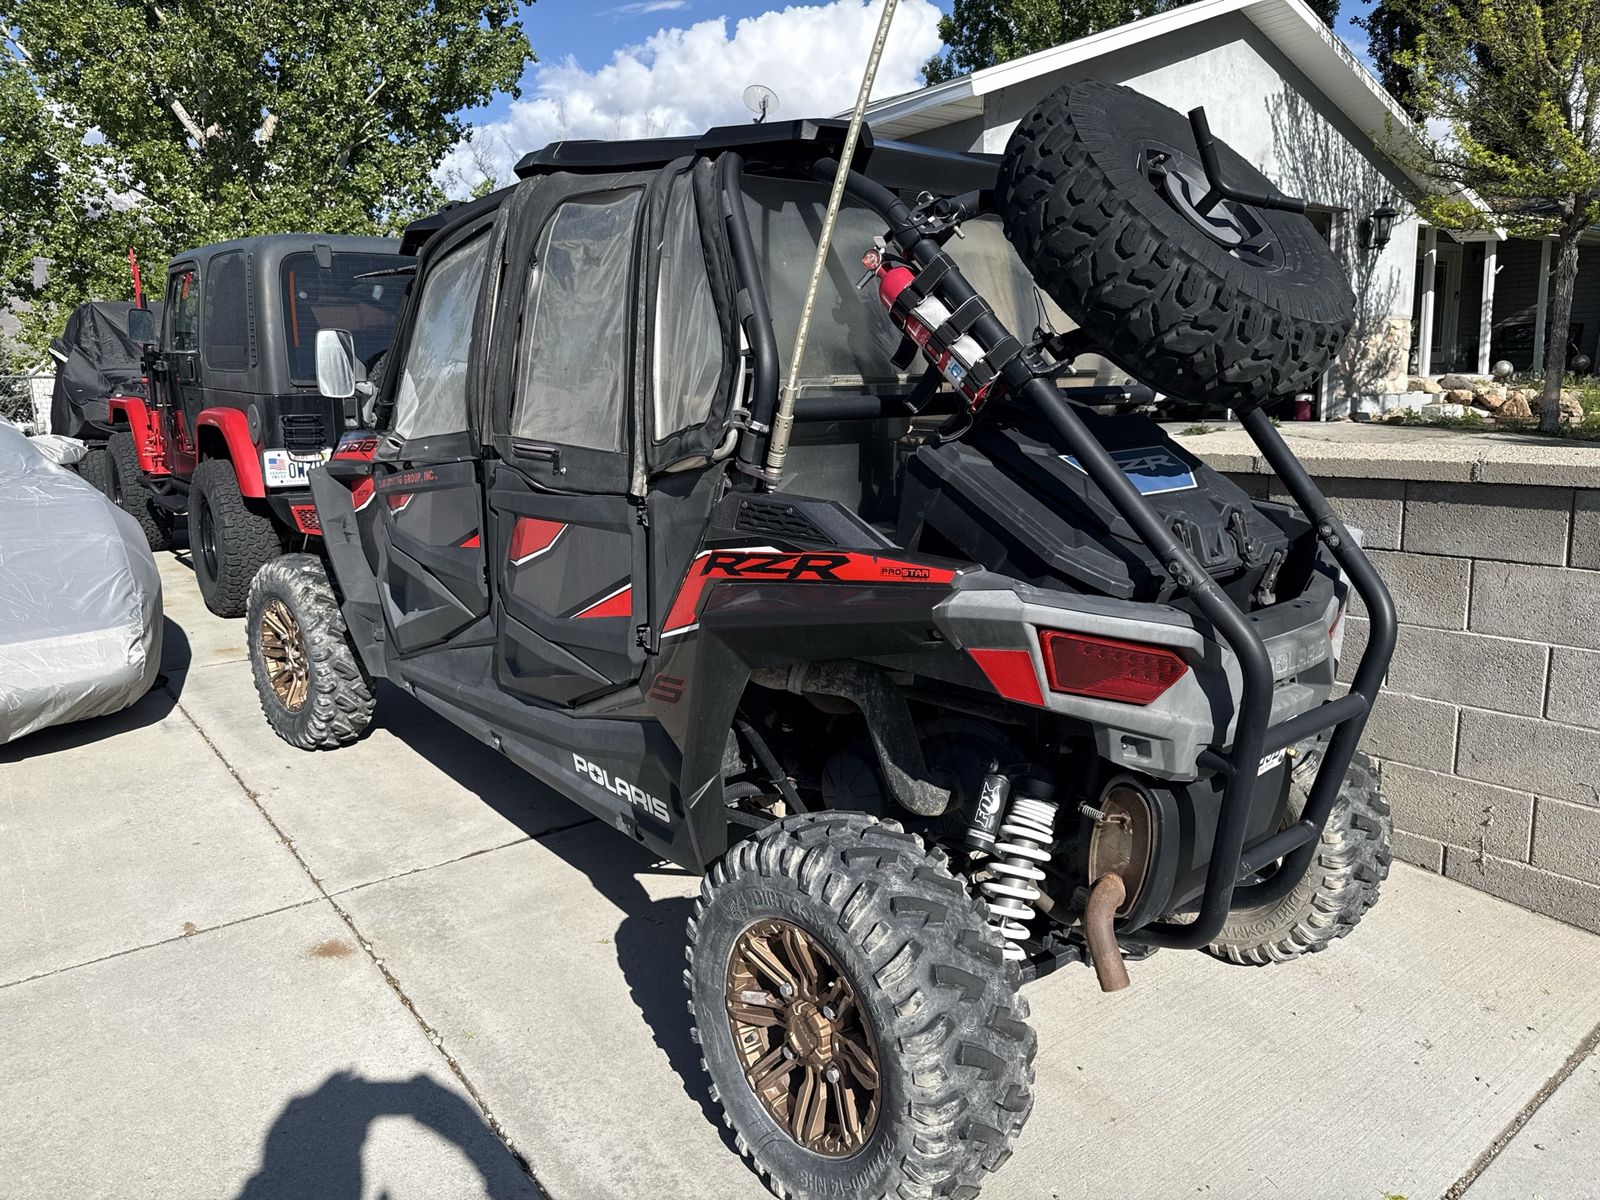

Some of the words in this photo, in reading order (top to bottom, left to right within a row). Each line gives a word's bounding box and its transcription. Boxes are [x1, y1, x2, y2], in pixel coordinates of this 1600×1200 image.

[1113, 455, 1177, 471] ZR
[357, 489, 370, 497] EPS
[700, 553, 851, 582] RZR
[1270, 637, 1328, 675] OLARIS
[645, 672, 690, 705] S
[572, 752, 671, 823] POLARIS
[974, 781, 1002, 829] FOX
[751, 887, 786, 910] DIRT
